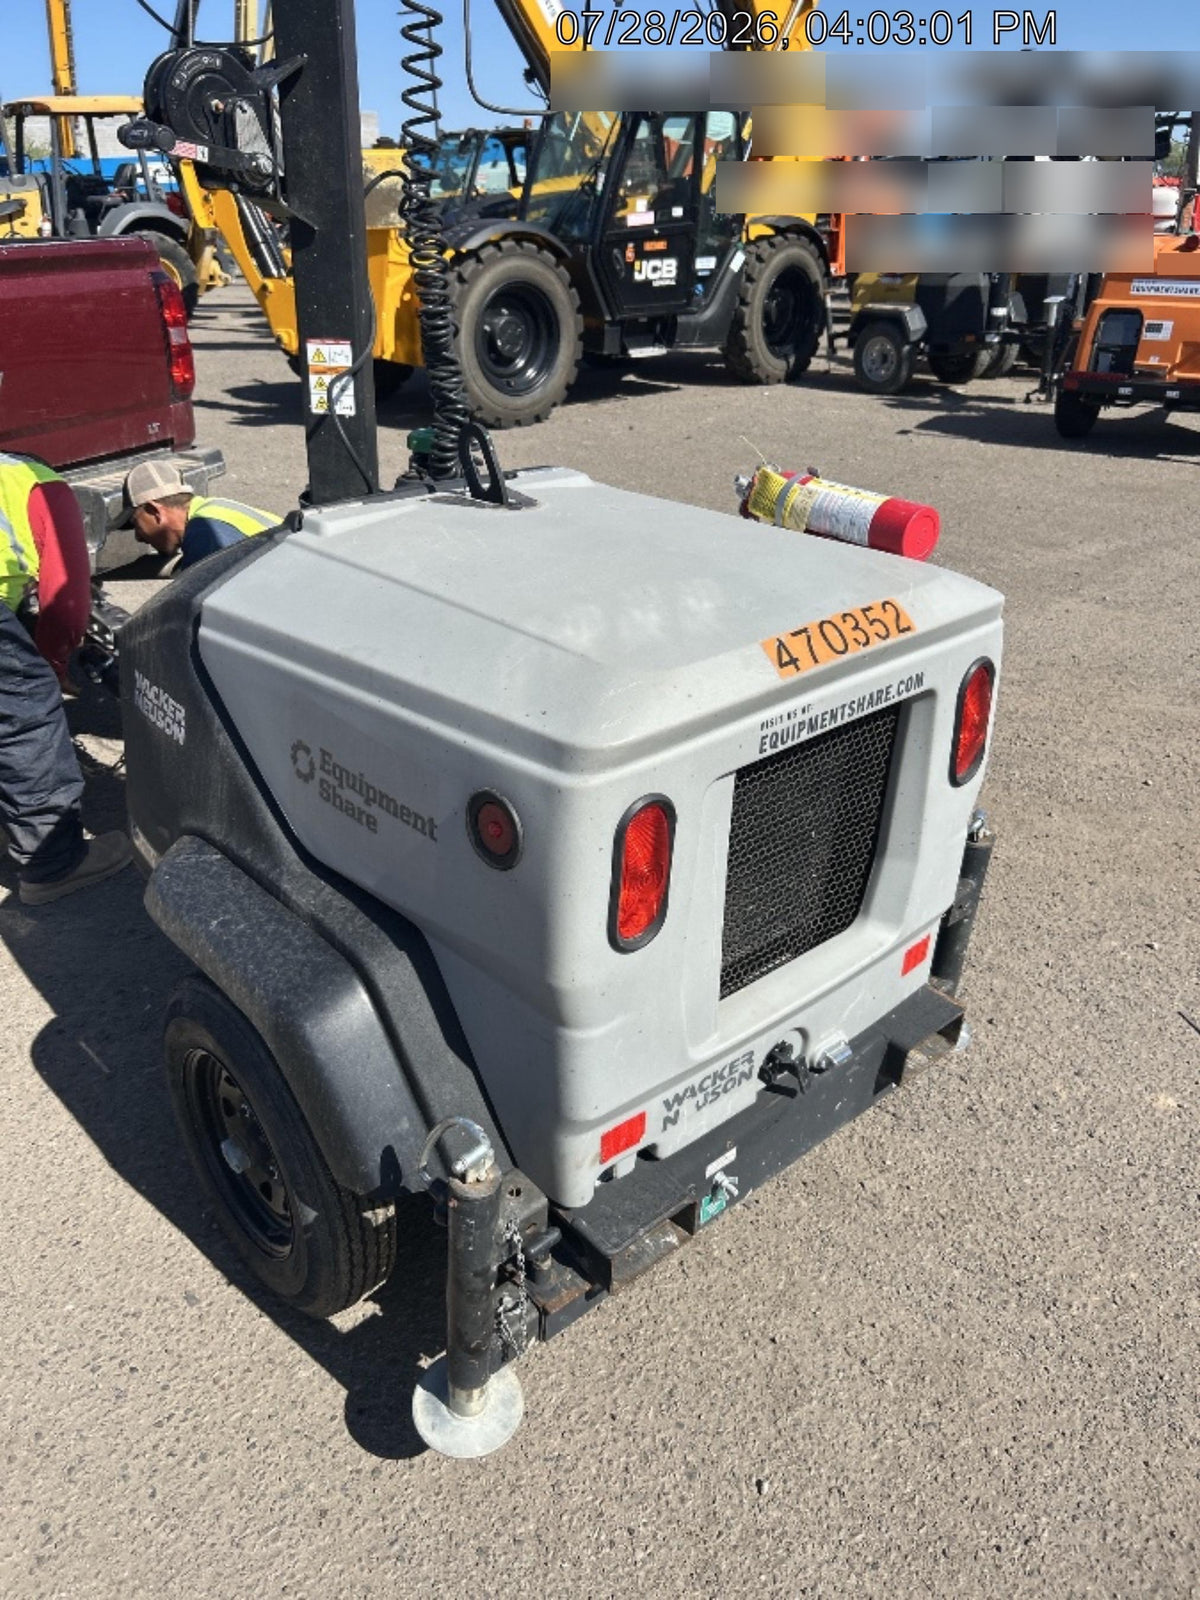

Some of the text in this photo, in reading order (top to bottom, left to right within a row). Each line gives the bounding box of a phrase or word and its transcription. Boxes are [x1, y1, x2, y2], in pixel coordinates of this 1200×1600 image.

[634, 258, 678, 281] JCB
[776, 600, 912, 673] 470352
[135, 668, 186, 725] WACKER
[135, 689, 186, 746] NEUSON
[758, 671, 925, 755] EQUIPMENTSHARE.COM
[318, 778, 379, 835] Share
[319, 748, 439, 843] Equipment
[662, 1049, 755, 1113] WACKER
